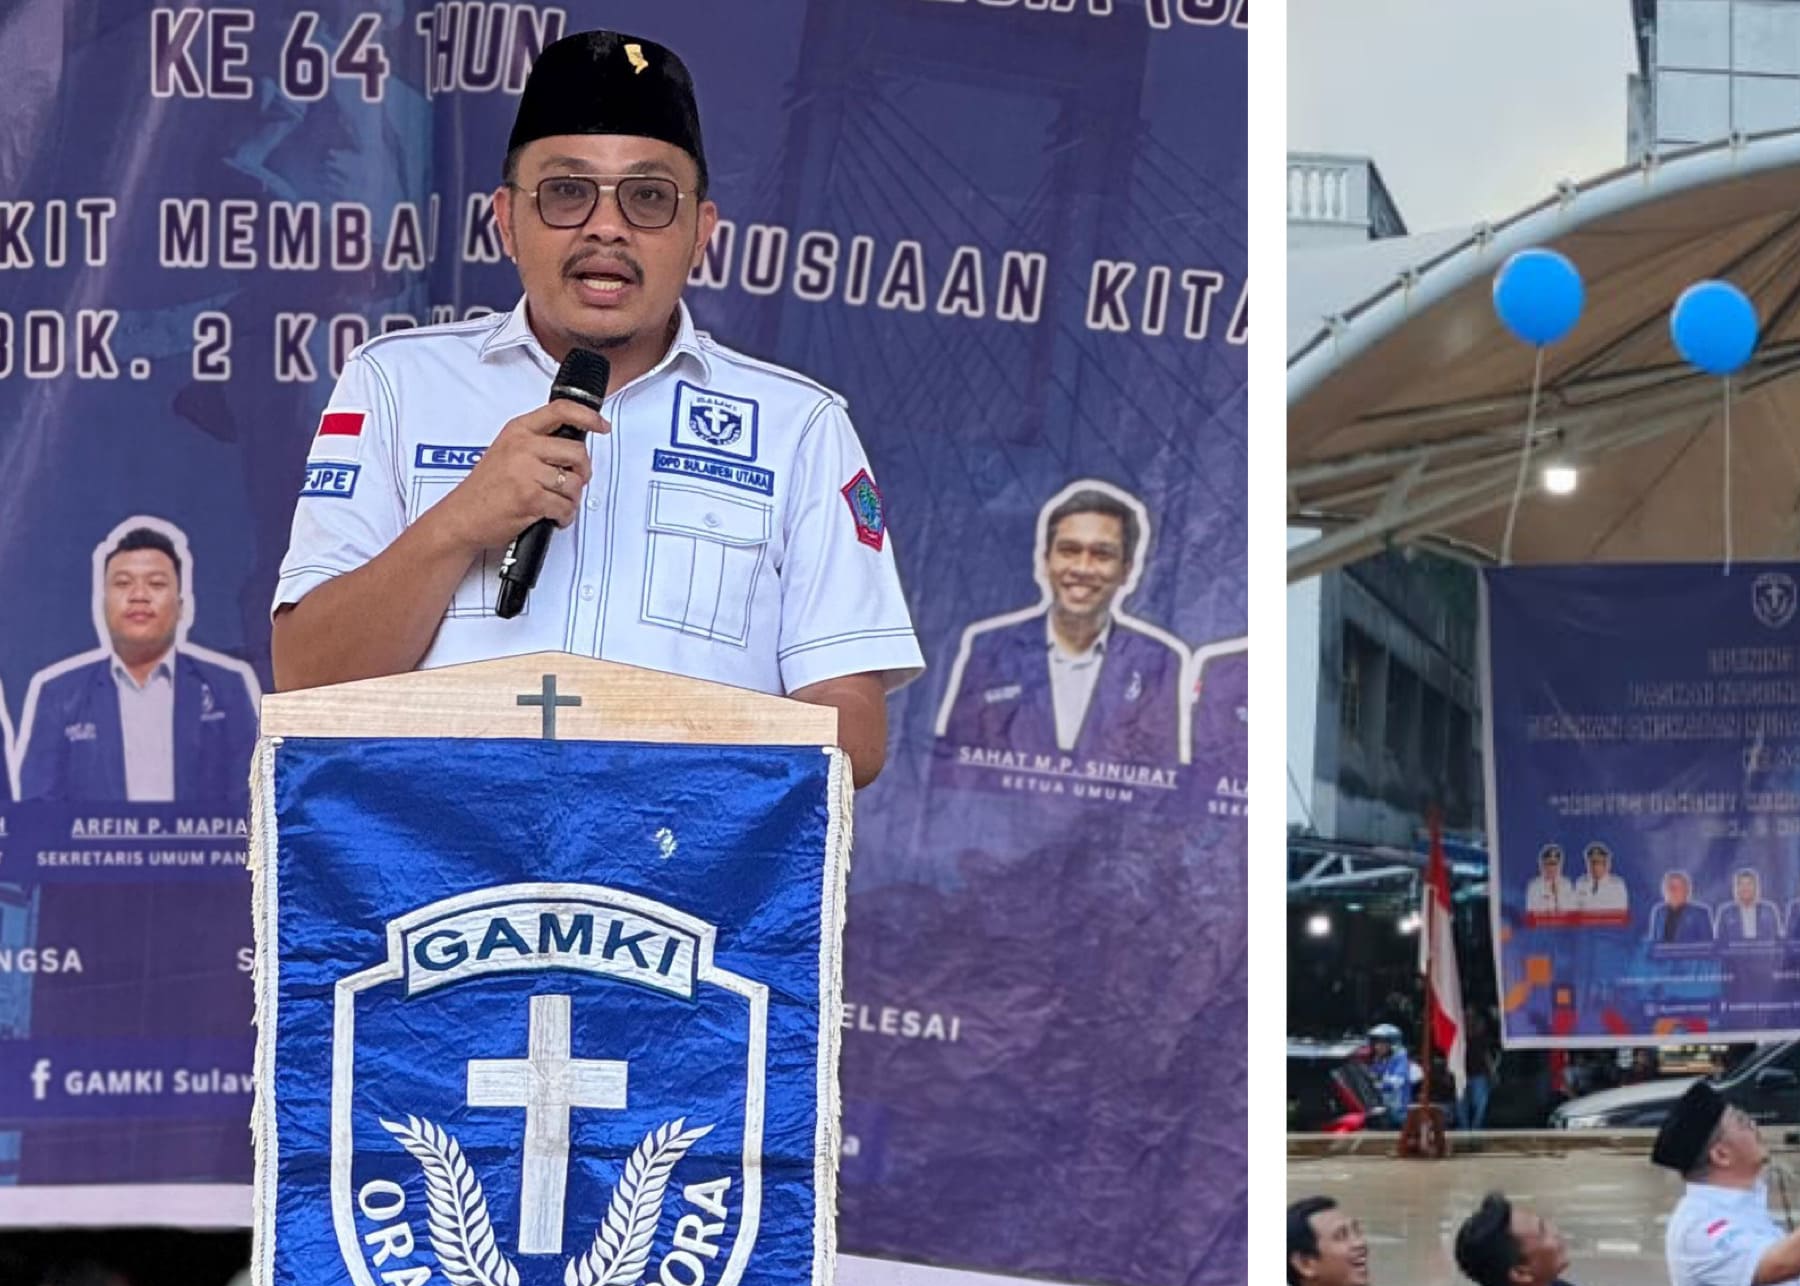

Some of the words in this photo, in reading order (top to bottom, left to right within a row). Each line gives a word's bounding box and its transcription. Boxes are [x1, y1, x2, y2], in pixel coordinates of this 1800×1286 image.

[151, 9, 254, 98] KE
[280, 13, 389, 101] 64
[192, 311, 232, 382] 2
[959, 746, 1025, 769] SAHAT
[1084, 760, 1178, 787] SINURAT
[1001, 775, 1065, 794] KETUA
[1073, 784, 1134, 802] UMUM
[72, 817, 140, 836] ARFIN
[146, 817, 168, 835] P.
[37, 851, 144, 867] SEKRETARIS
[150, 852, 204, 866] UMUM
[412, 912, 682, 977] GAMKI
[64, 1070, 163, 1095] GAMKI
